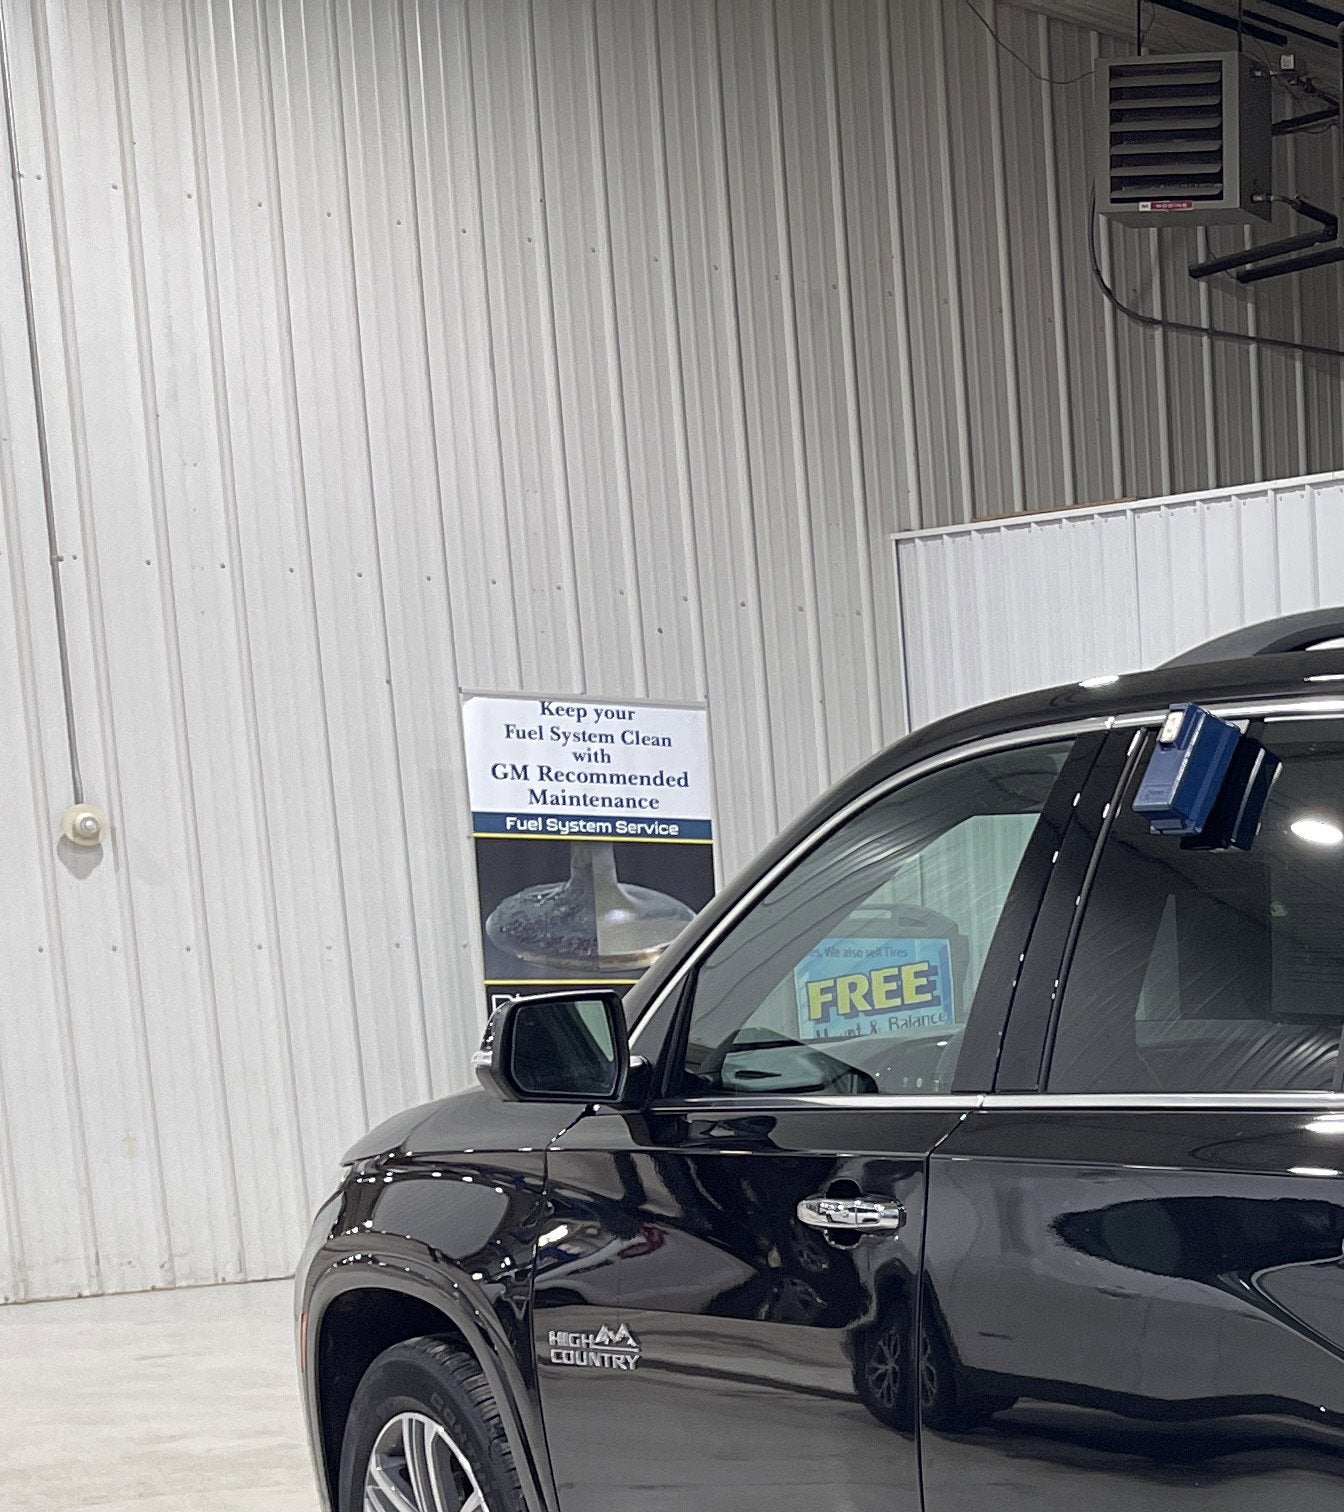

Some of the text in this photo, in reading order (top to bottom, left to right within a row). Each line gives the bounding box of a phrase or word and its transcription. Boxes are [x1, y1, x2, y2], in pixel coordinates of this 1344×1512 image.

[540, 701, 636, 725] Keep your
[504, 723, 673, 747] Fuel System Clean
[572, 747, 611, 764] with
[491, 763, 690, 788] GM Recommended
[528, 788, 660, 810] Maintenance
[505, 816, 680, 836] Fuel System Service
[806, 961, 935, 1021] FREE
[869, 1019, 879, 1034] &
[888, 1012, 945, 1031] Balance
[548, 1331, 595, 1349] HIGH
[550, 1349, 640, 1370] COUNTRY
